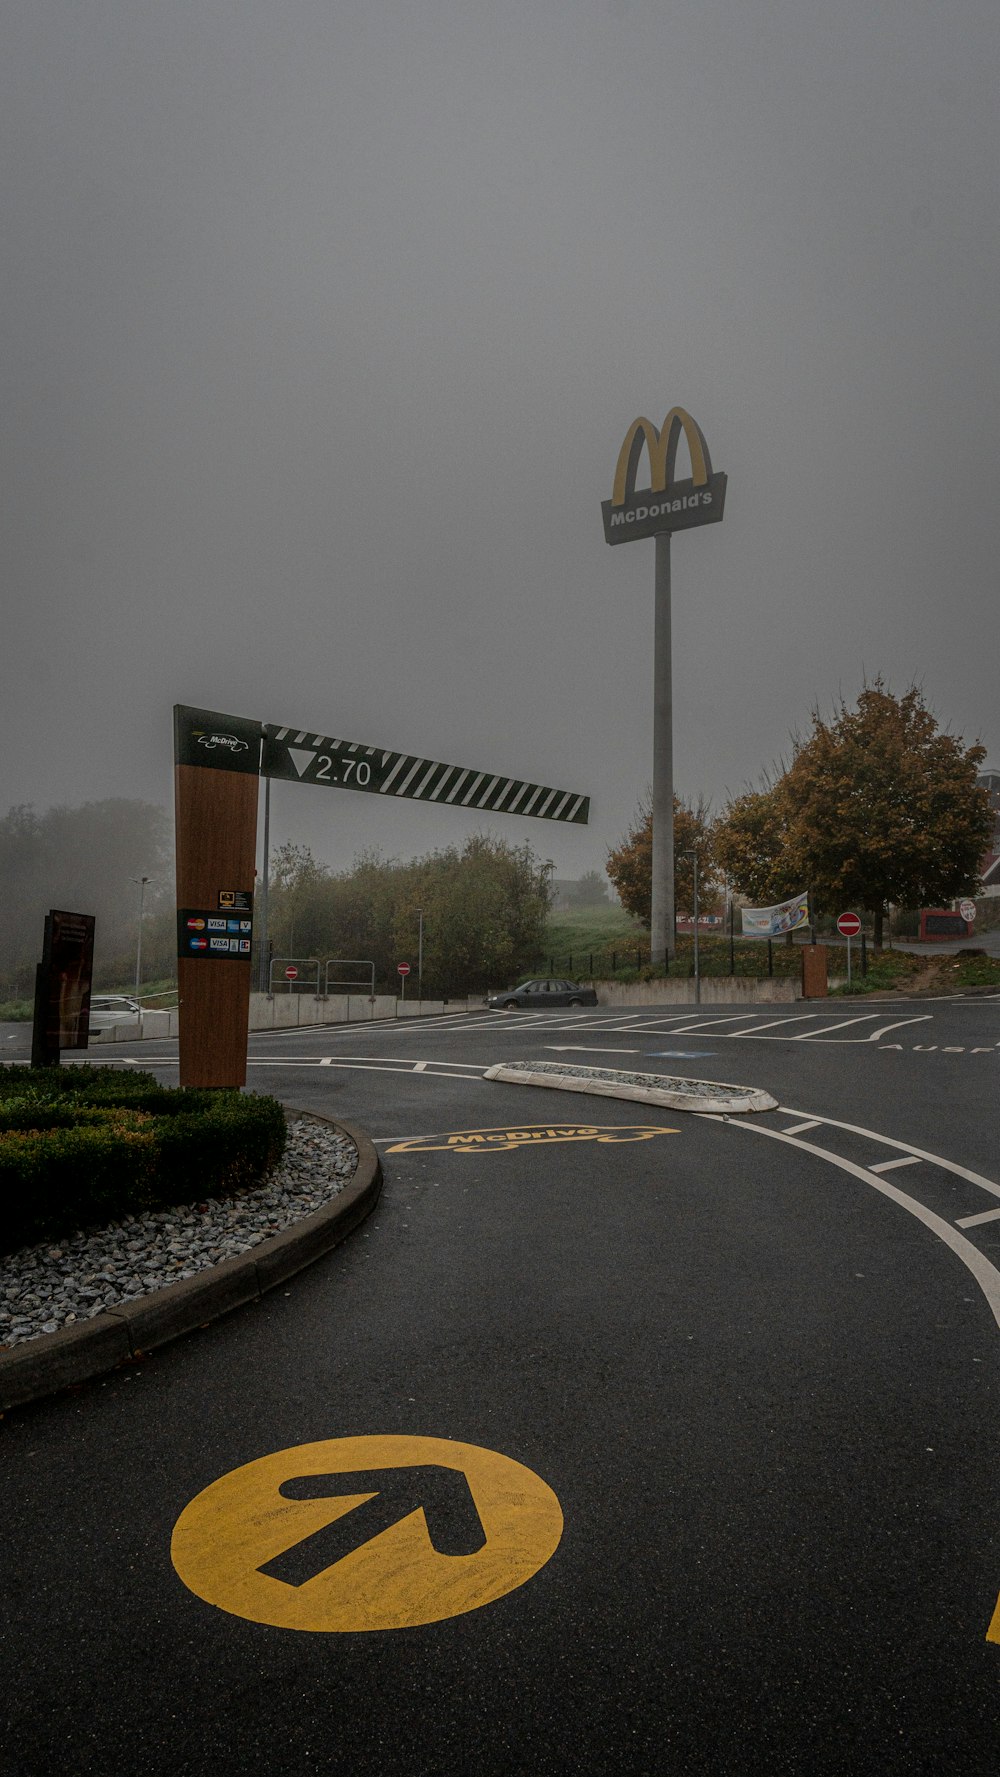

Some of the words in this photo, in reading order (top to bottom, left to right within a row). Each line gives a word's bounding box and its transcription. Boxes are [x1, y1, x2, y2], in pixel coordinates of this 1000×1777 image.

[610, 492, 713, 527] McDonald's
[210, 735, 238, 746] McDrive
[315, 755, 371, 786] 2.70
[877, 1043, 1000, 1054] AUSF
[447, 1128, 600, 1145] McDrive
